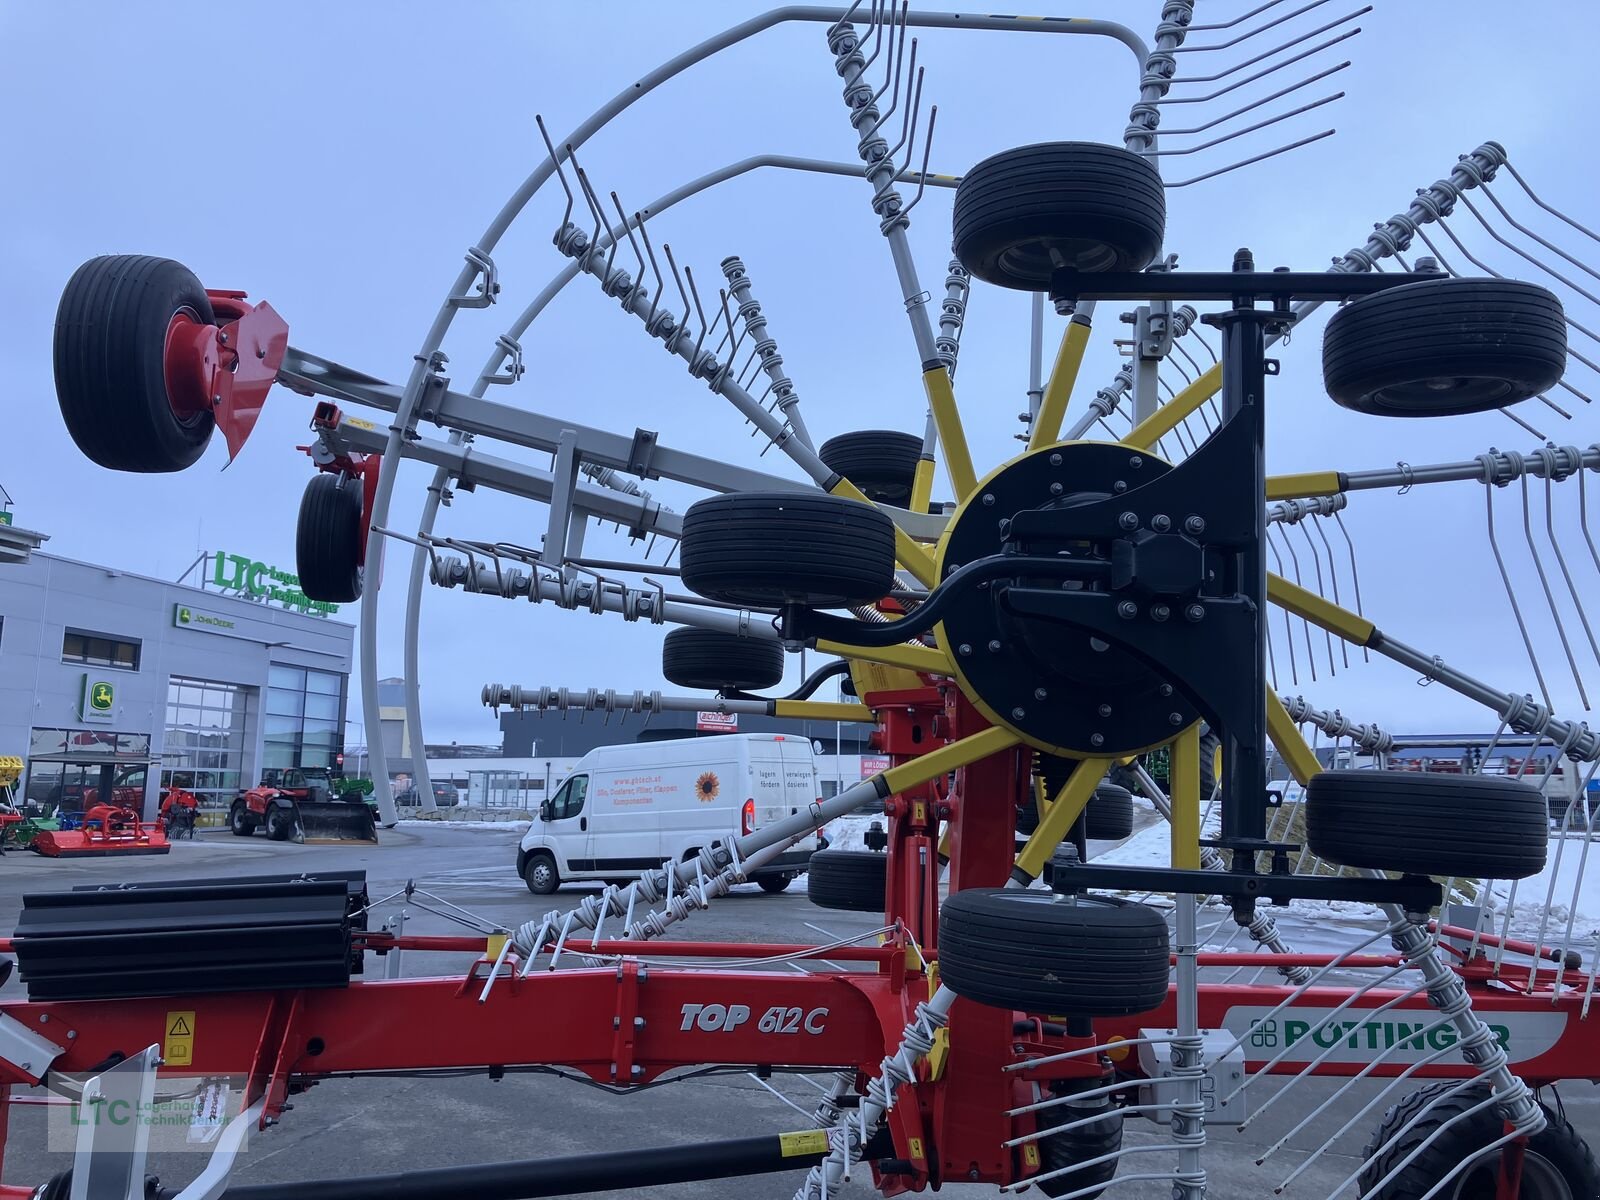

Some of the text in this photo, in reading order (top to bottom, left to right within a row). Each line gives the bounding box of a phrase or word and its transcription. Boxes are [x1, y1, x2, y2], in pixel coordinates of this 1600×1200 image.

[214, 551, 268, 595] LTC
[759, 770, 812, 780] lagern verwiegen
[760, 780, 809, 788] fördern dosieren
[680, 1003, 830, 1035] TOP 612 C
[1284, 1019, 1512, 1052] PÖTTINGR
